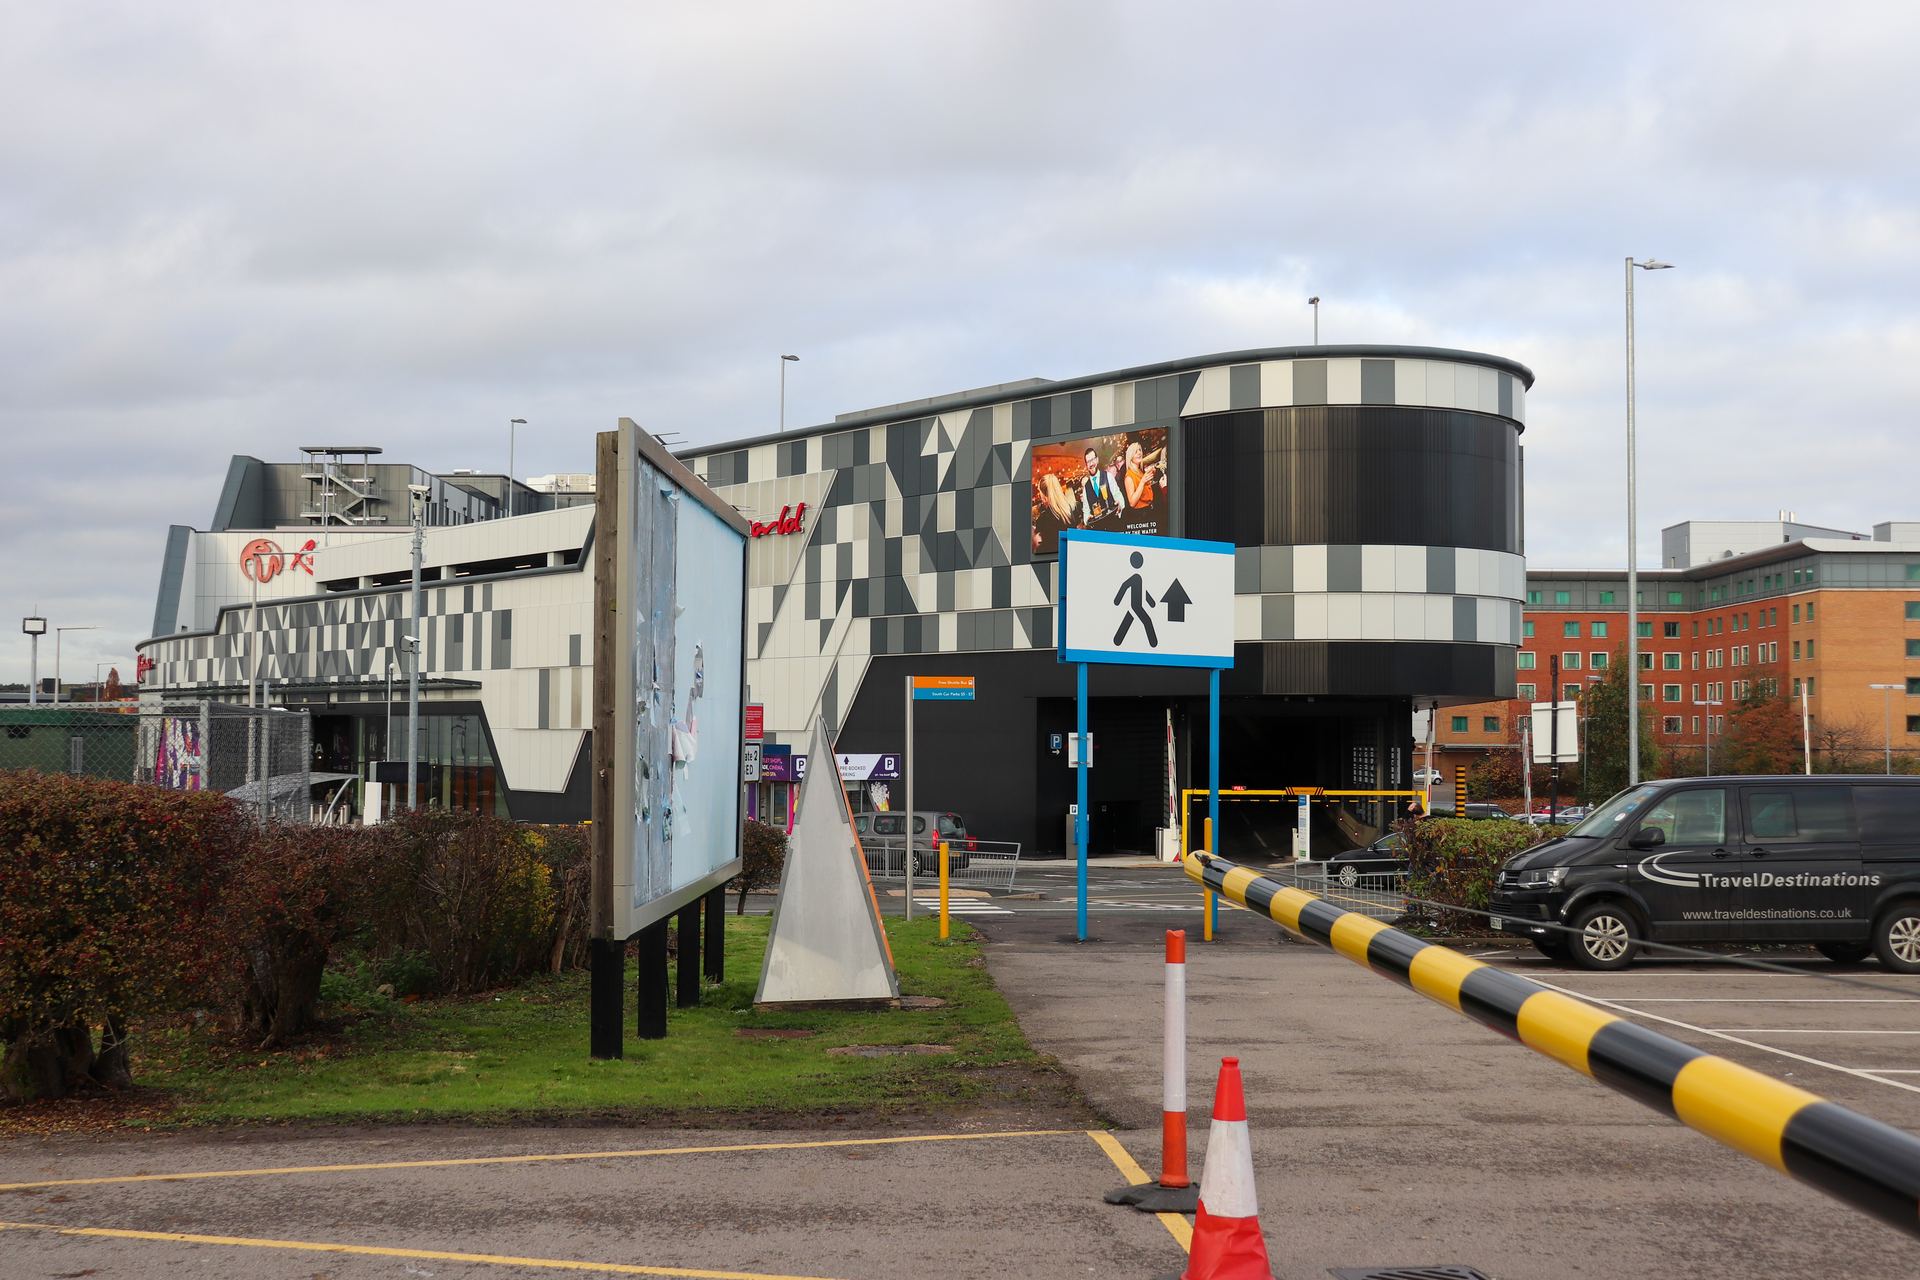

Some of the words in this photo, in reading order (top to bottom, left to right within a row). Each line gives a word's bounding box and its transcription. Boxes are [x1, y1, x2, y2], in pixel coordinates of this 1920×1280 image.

[748, 502, 805, 538] orld
[1126, 522, 1149, 530] WELCOME
[1053, 735, 1060, 747] P
[753, 750, 758, 761] 2
[798, 760, 805, 769] P
[887, 759, 893, 768] P
[1701, 872, 1880, 888] TravelDestinations
[1682, 908, 1852, 920] www.traveldestinations.co.uk
